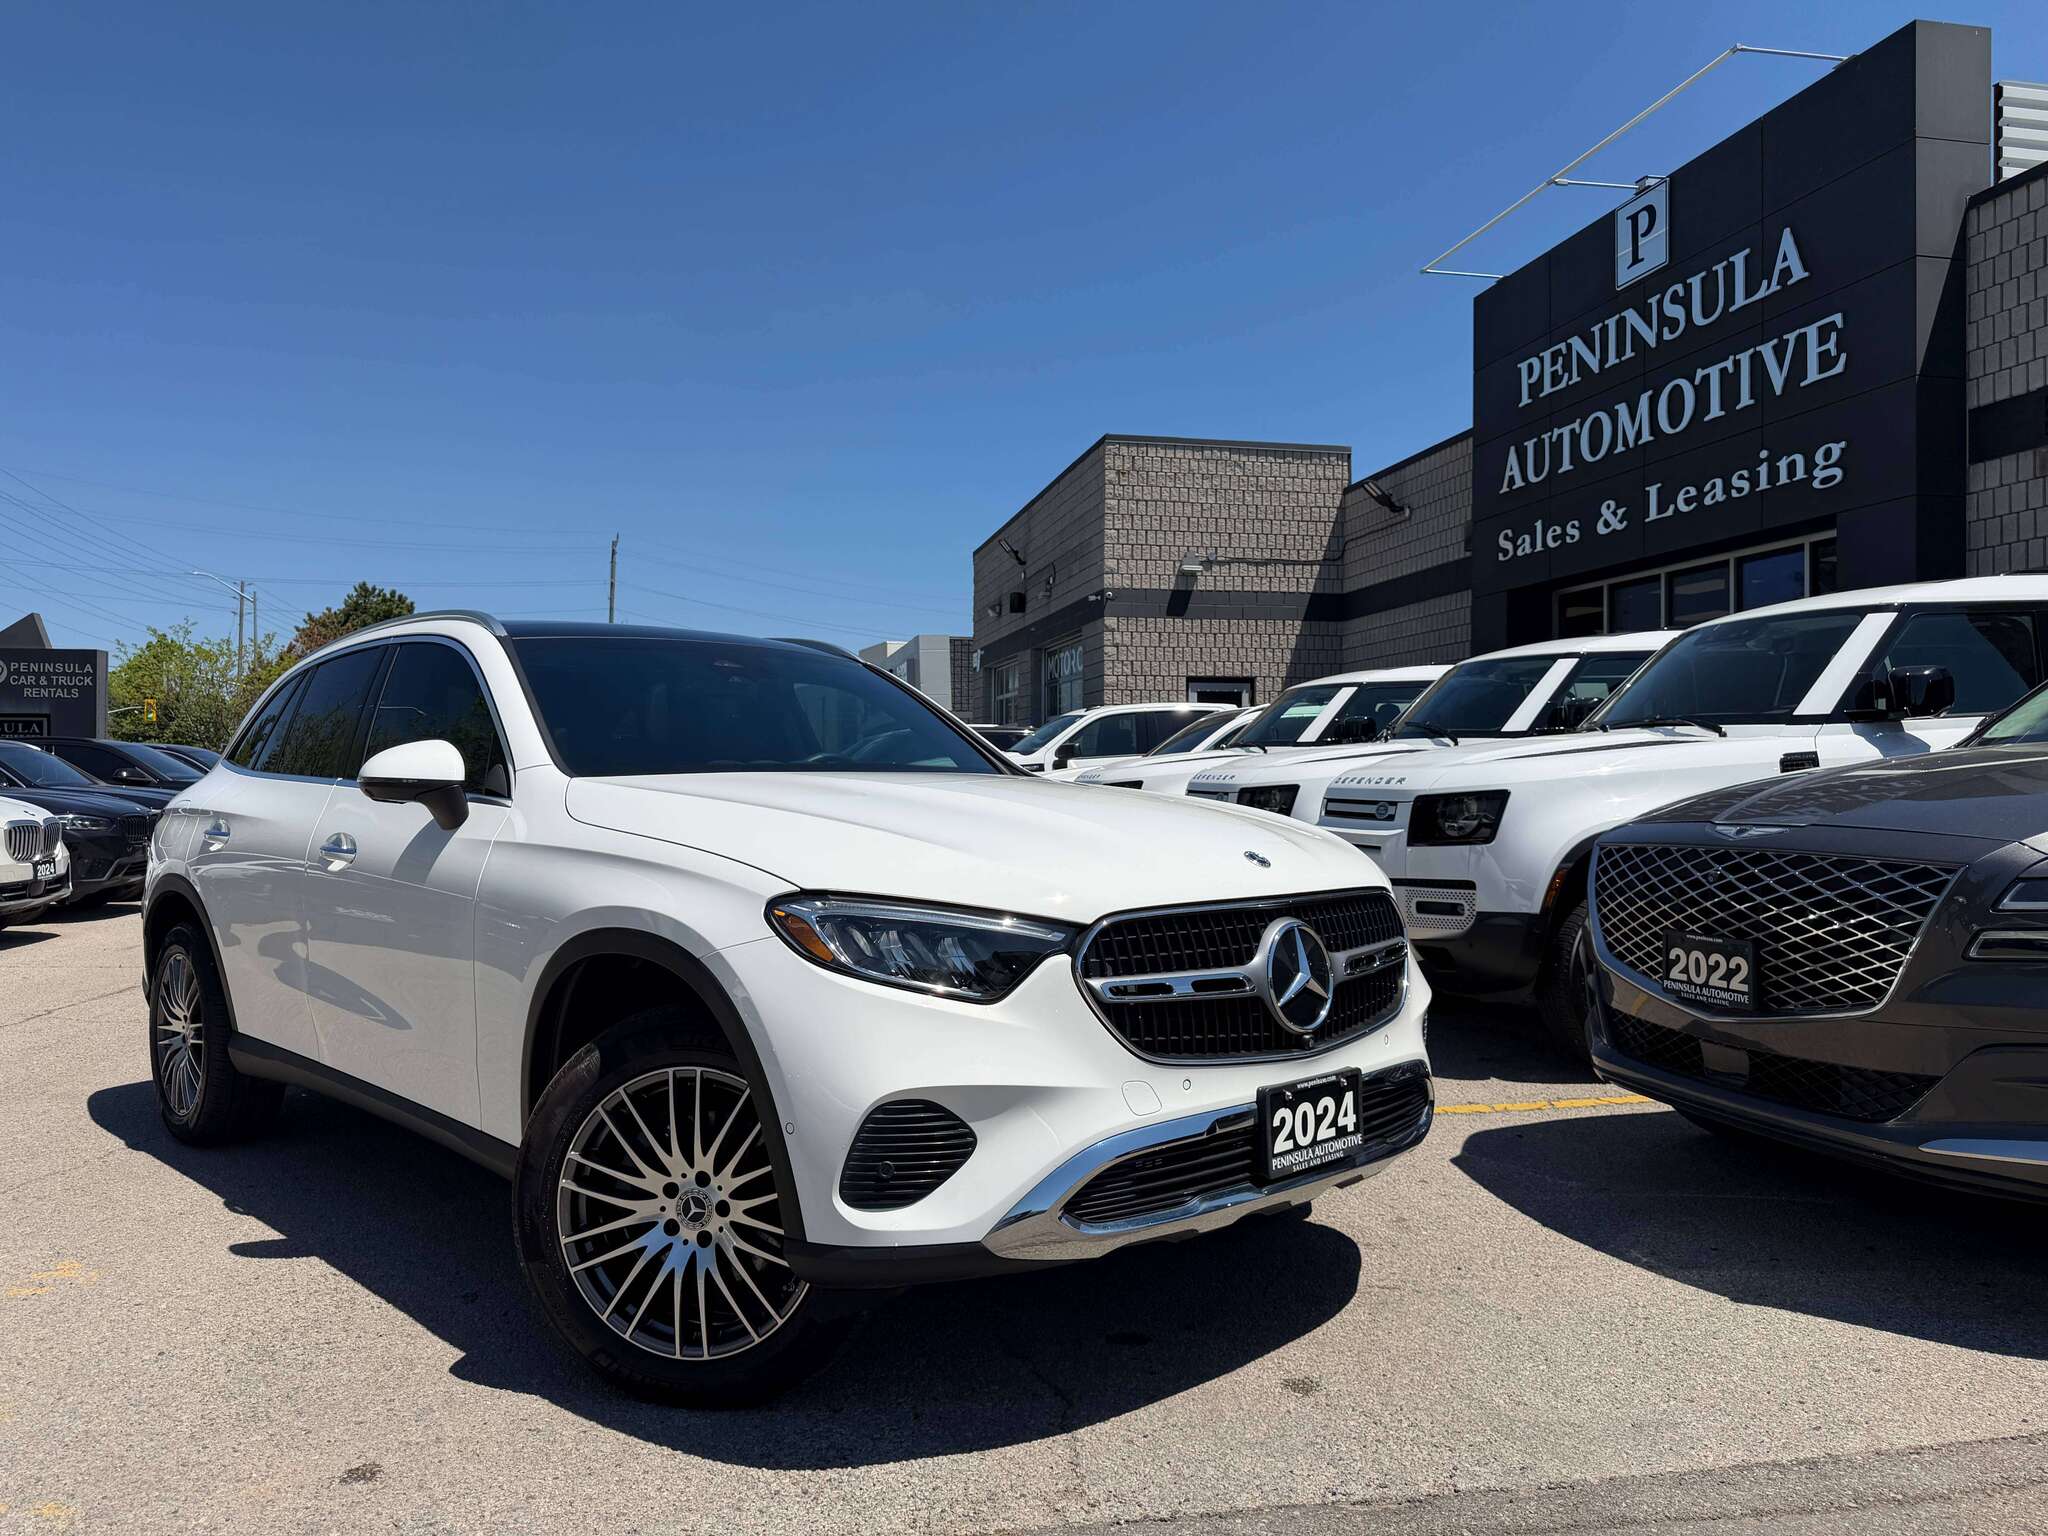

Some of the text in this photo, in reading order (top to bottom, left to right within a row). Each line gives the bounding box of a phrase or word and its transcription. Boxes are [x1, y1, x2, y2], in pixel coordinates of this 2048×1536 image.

[1626, 203, 1657, 270] P
[1517, 227, 1810, 407] PENINSULA
[1499, 312, 1847, 494] AUTOMOTIVE
[1498, 440, 1847, 561] Sales & Leasing
[10, 662, 94, 673] PENINSULA
[10, 675, 93, 686] CAR & TRUCK
[23, 687, 79, 698] RENTALS
[0, 722, 40, 733] ULA
[37, 862, 55, 876] 2024
[1669, 947, 1749, 992] 2022
[1663, 980, 1750, 1004] PENINSULA AUTOMOTIVE
[1272, 1090, 1357, 1154] 2024
[1272, 1133, 1363, 1170] PENINSULA AUTOMOTIVE
[1293, 1151, 1344, 1172] SALES AND LEASING
